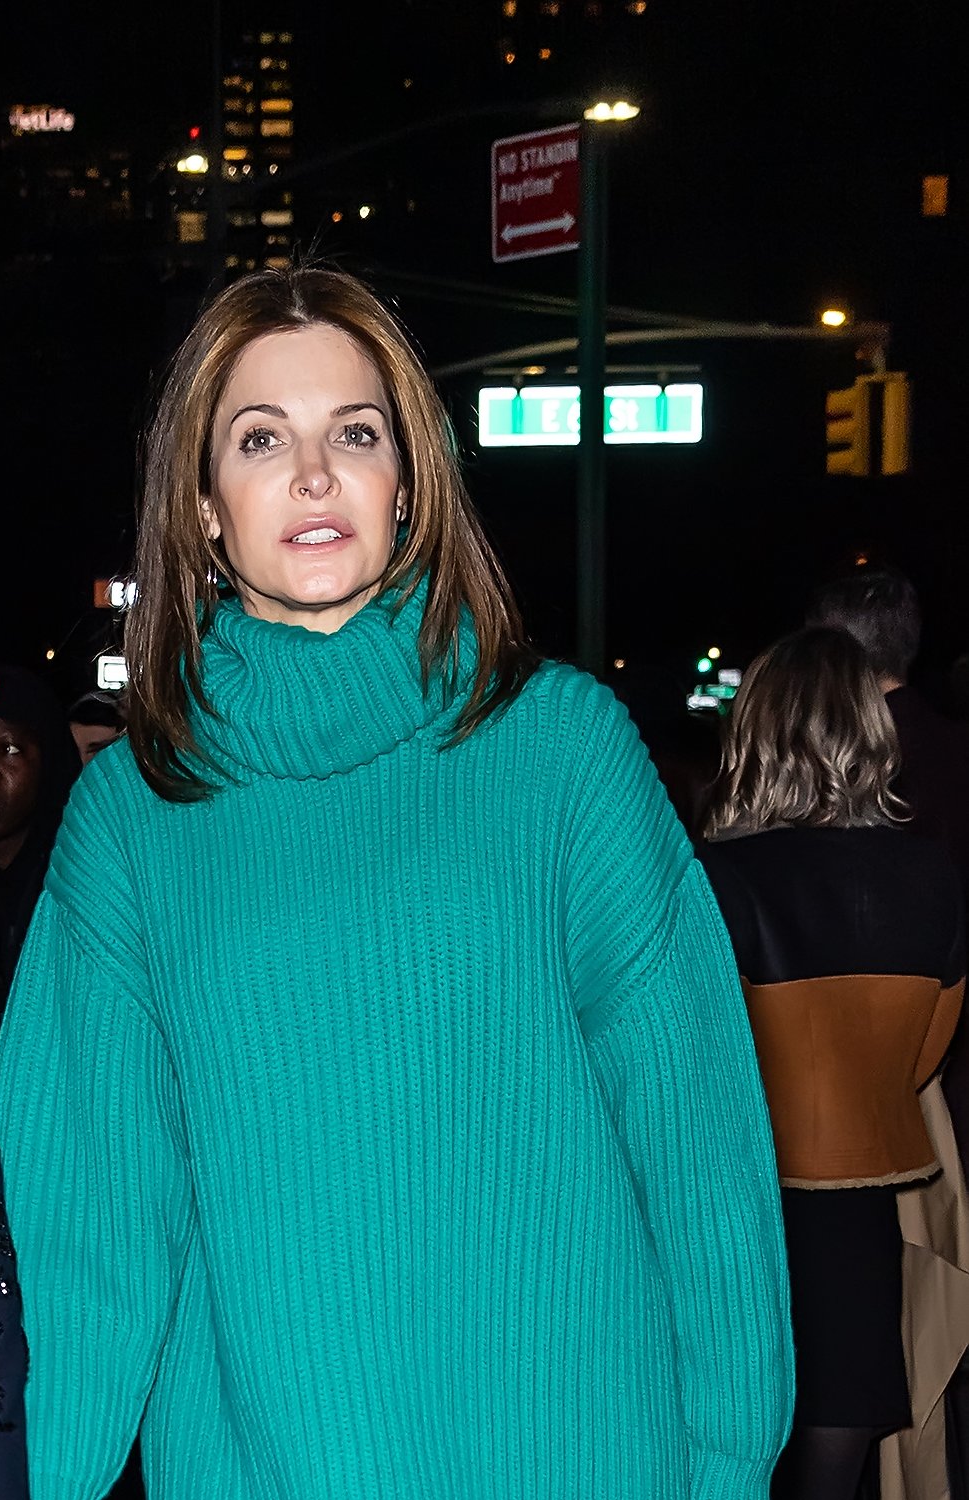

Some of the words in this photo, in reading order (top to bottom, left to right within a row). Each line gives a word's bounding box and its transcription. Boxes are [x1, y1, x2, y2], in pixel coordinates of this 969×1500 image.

[498, 152, 518, 175] NO
[520, 139, 579, 172] STANDIN
[542, 399, 560, 432] E
[609, 398, 639, 431] St
